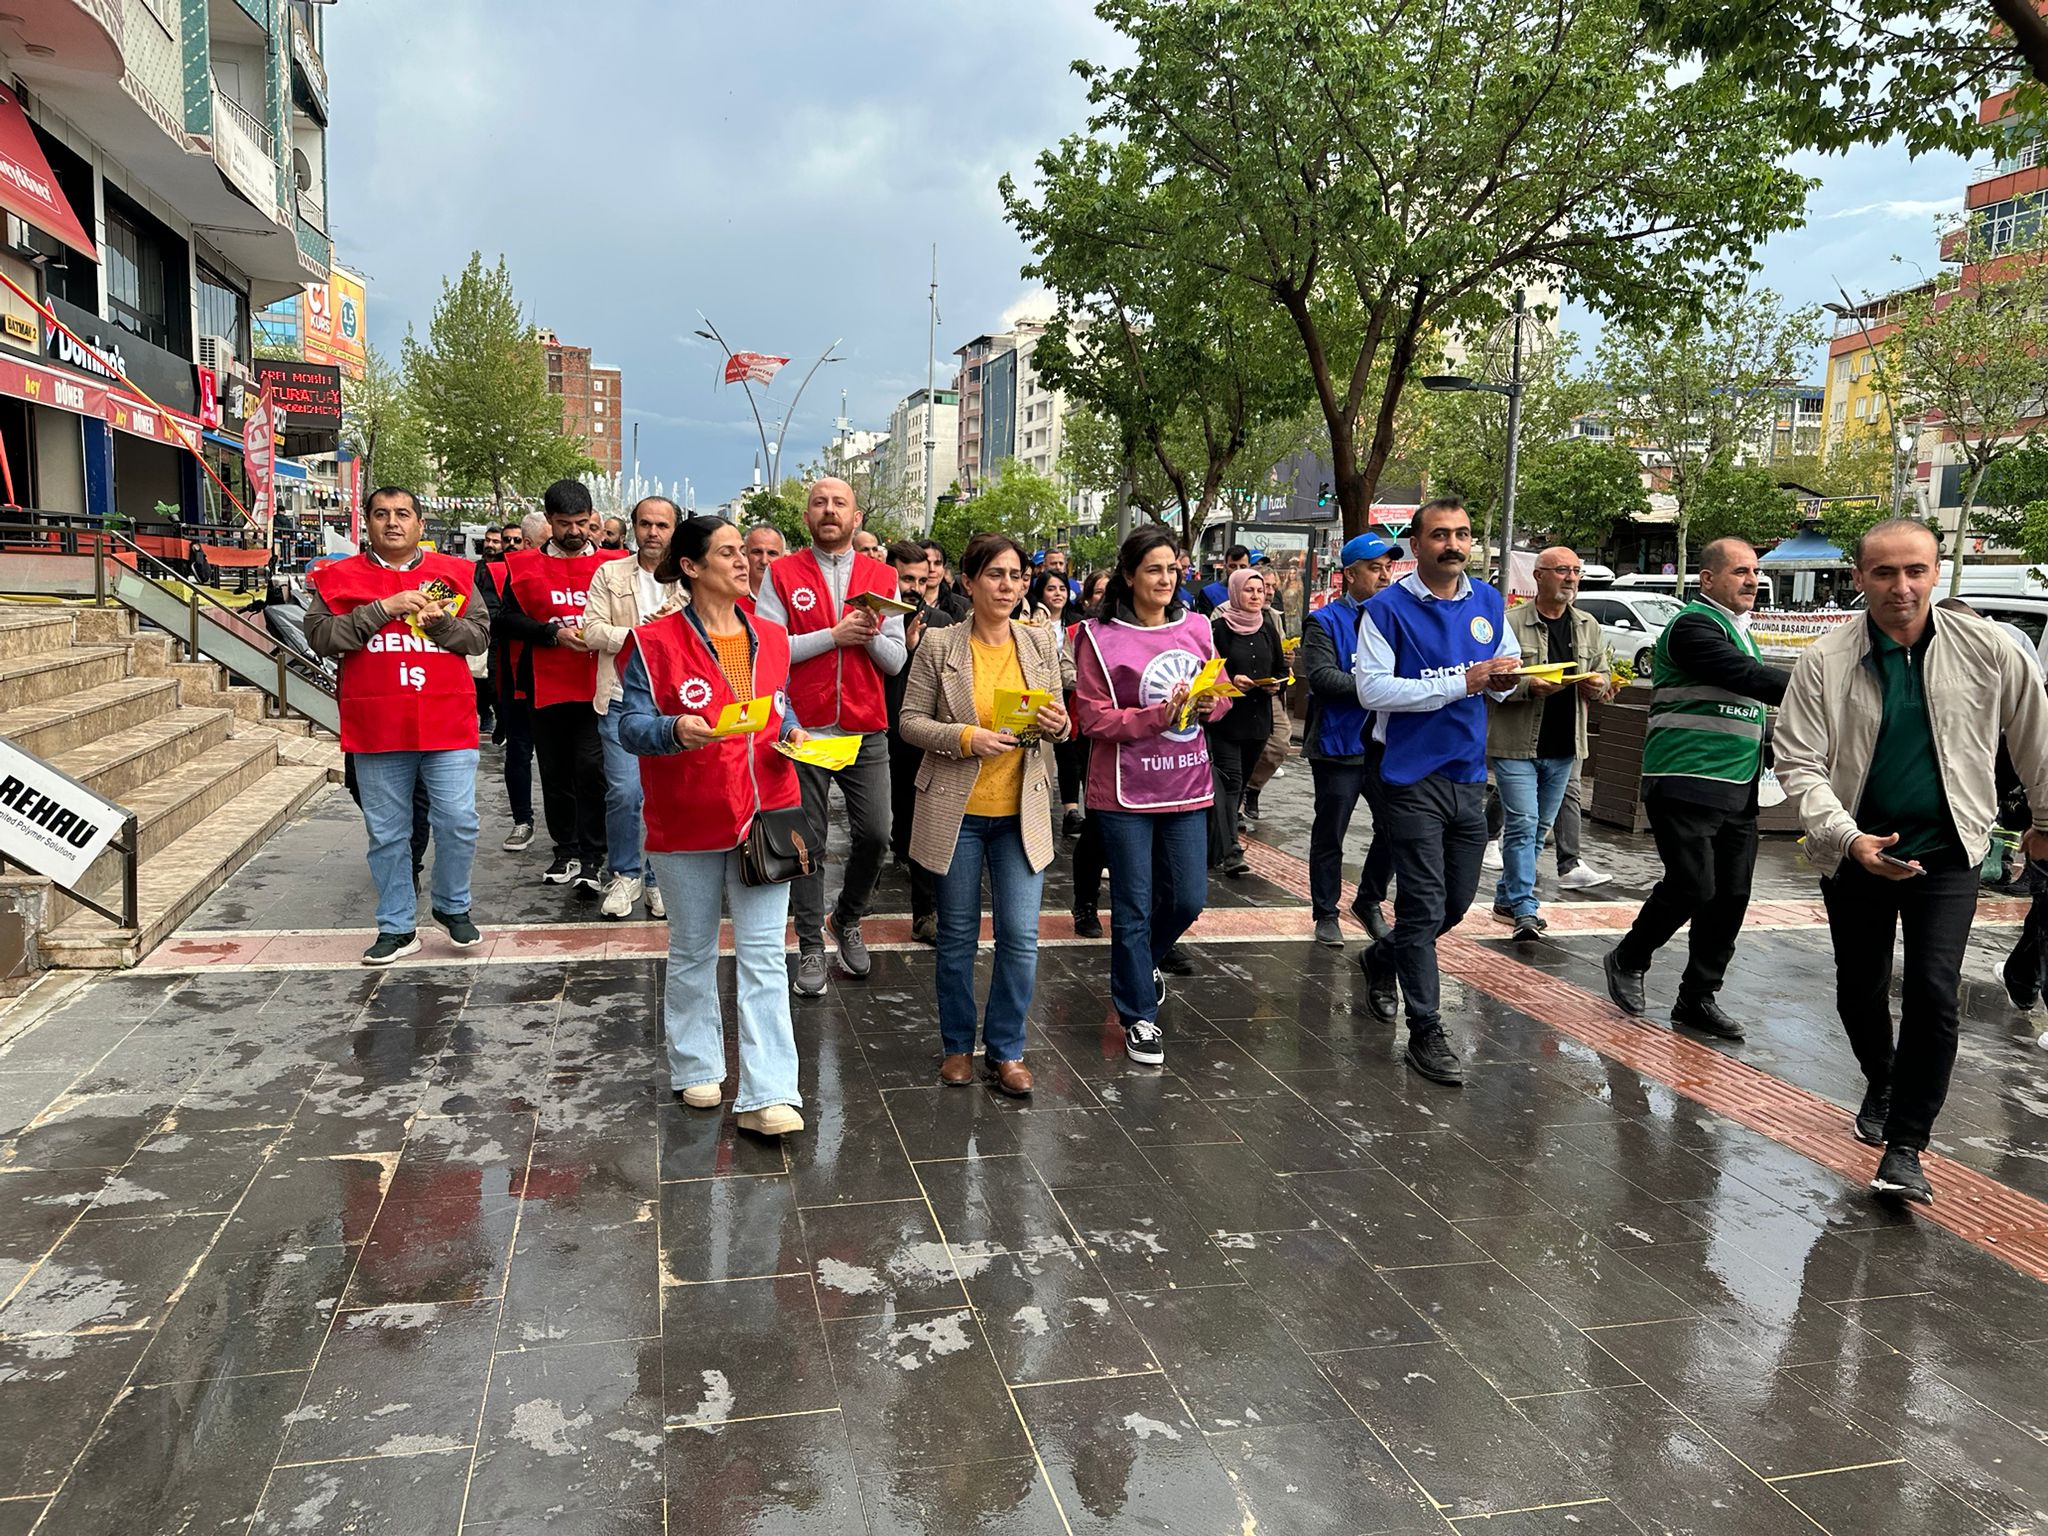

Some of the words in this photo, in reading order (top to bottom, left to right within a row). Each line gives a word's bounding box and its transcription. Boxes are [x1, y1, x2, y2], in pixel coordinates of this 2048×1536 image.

[54, 379, 84, 409] DÖNER
[133, 409, 154, 436] DÖNER
[550, 587, 590, 606] DİS
[399, 661, 427, 692] İŞ
[1717, 703, 1759, 719] TEKSİF
[1141, 753, 1175, 772] TÜM
[0, 774, 99, 849] REHAU
[16, 820, 46, 841] Polymer
[44, 837, 77, 861] Solutions
